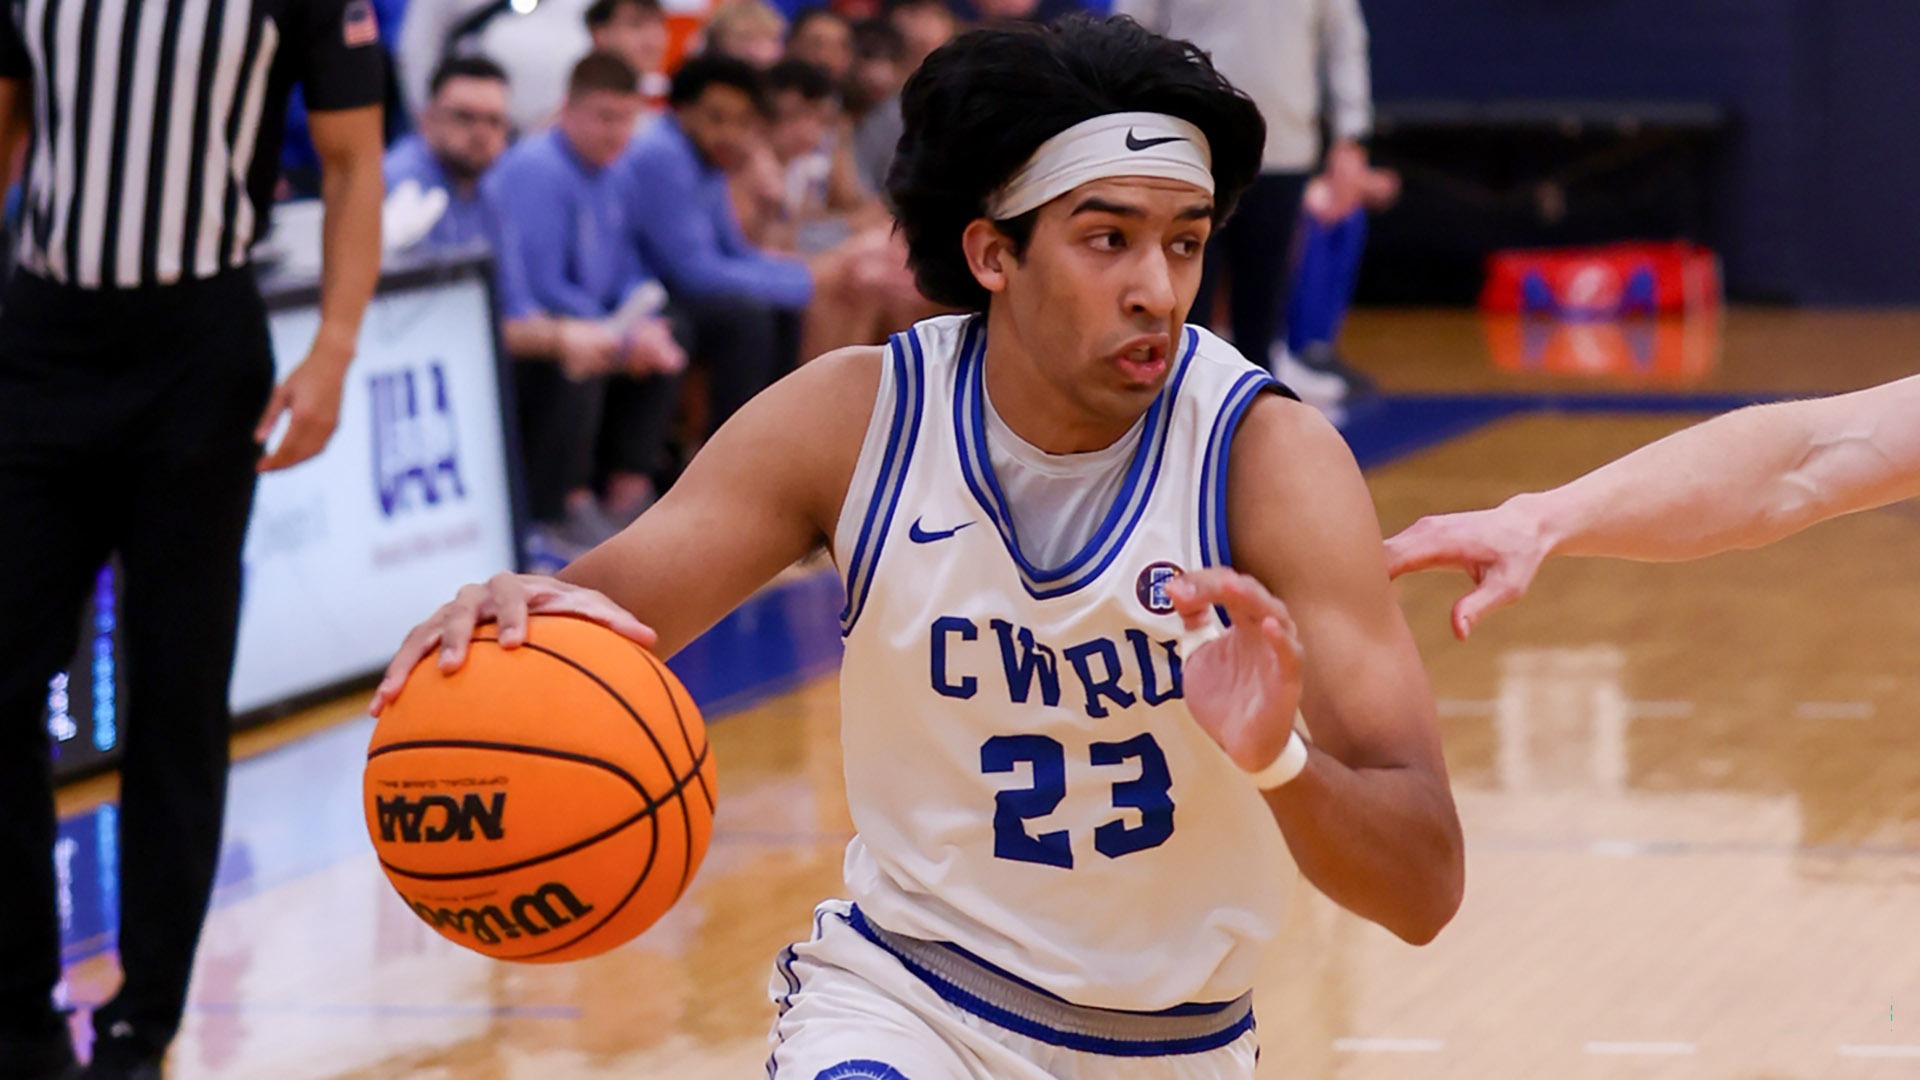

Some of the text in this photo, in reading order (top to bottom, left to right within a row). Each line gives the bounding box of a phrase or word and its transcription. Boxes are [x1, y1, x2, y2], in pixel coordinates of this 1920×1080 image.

[930, 615, 1184, 718] CWRU
[375, 792, 506, 843] NCAA
[980, 732, 1175, 870] 23
